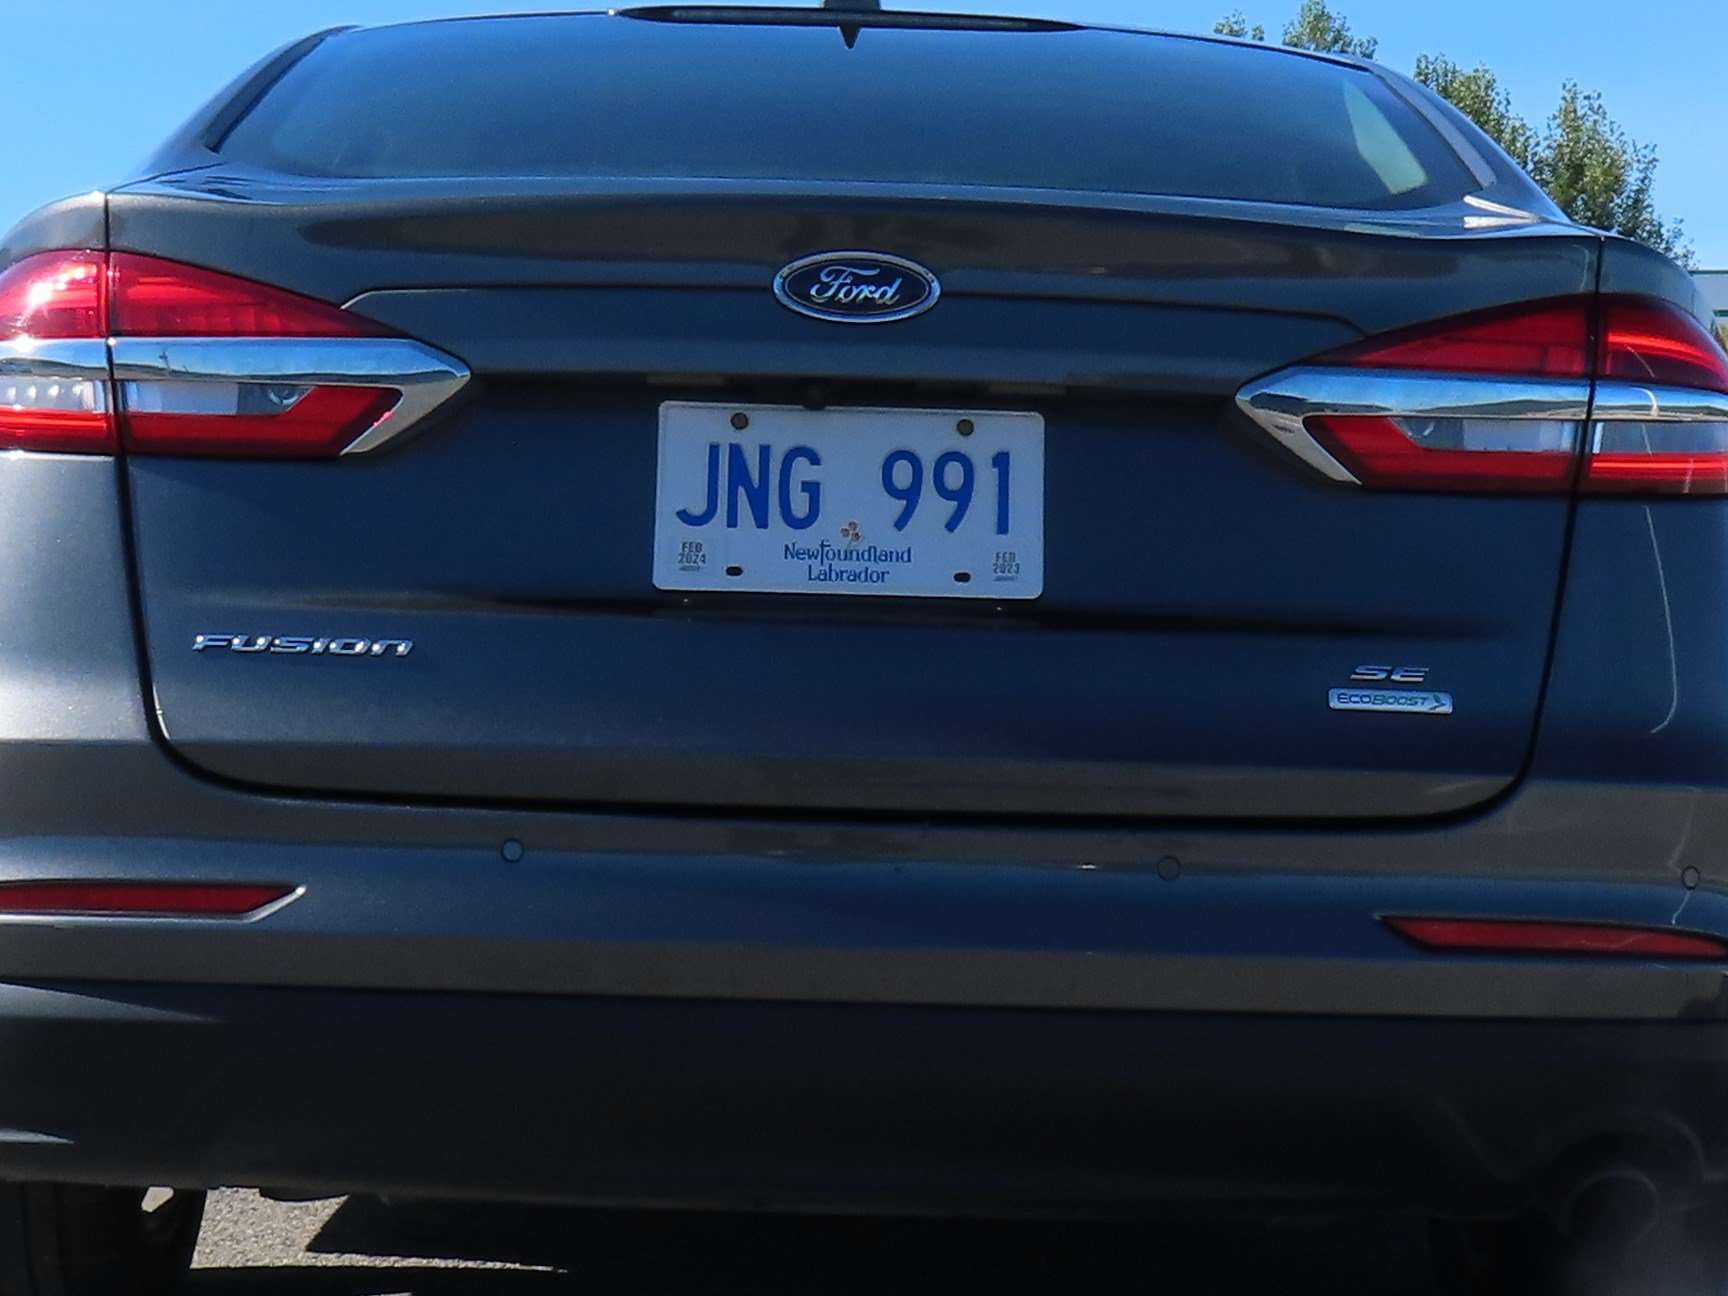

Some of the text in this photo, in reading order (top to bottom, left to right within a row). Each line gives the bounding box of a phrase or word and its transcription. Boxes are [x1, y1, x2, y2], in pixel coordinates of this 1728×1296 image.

[810, 266, 902, 304] Ford
[675, 442, 1011, 535] JNG 991
[784, 540, 912, 565] Newfoundland
[808, 564, 890, 584] Labrador
[192, 634, 414, 656] FUSION
[1349, 664, 1430, 683] SE
[1337, 692, 1426, 706] ECOBOOST
